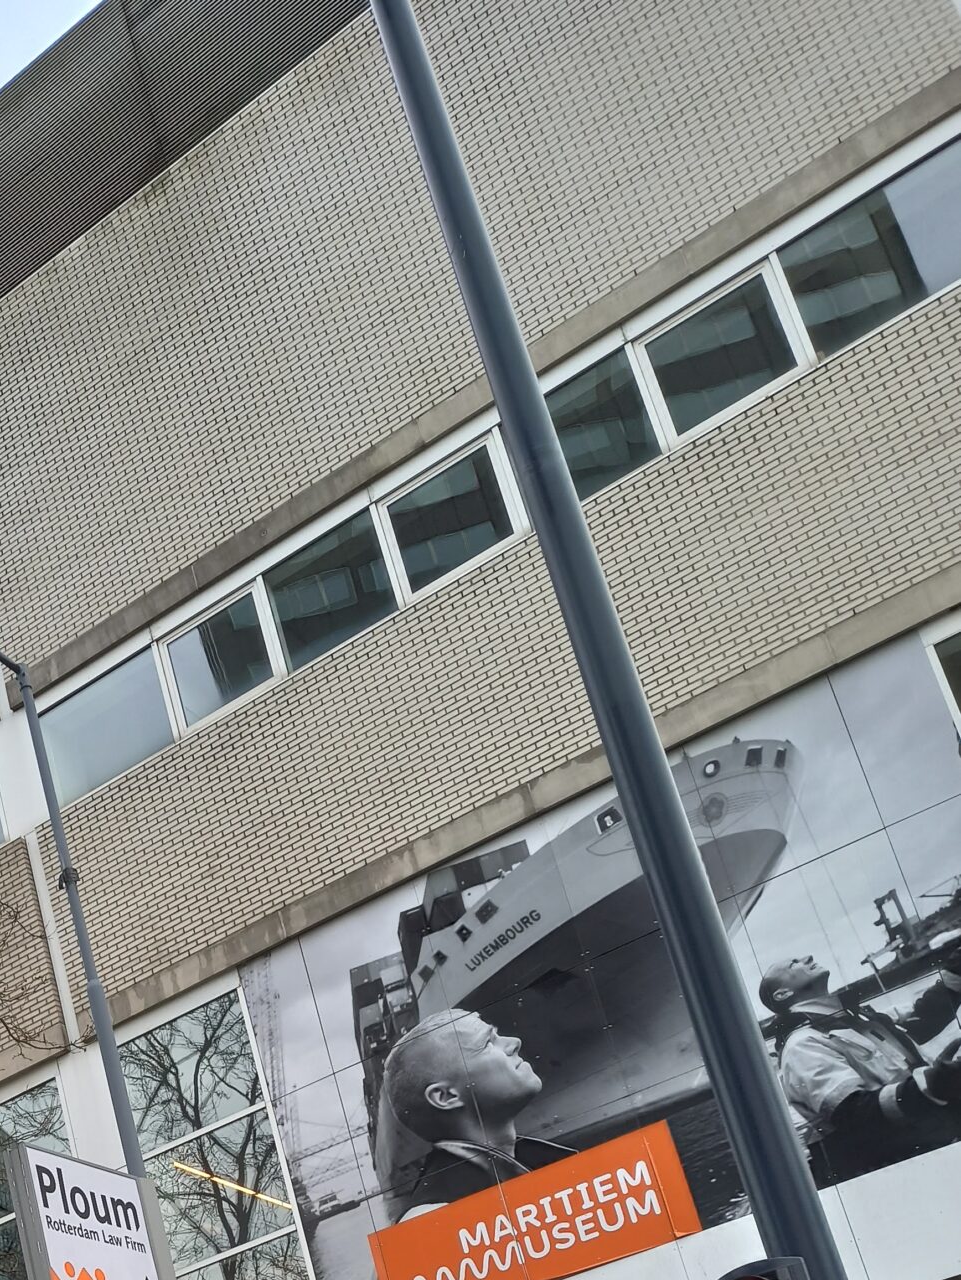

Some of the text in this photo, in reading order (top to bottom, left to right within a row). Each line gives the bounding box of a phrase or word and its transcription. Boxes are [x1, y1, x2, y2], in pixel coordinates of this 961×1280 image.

[464, 908, 542, 973] LUXEMBOURG
[35, 1164, 140, 1232] Ploum
[457, 1159, 653, 1254] MARITIEM
[45, 1214, 147, 1254] Rotterdam Law Firm
